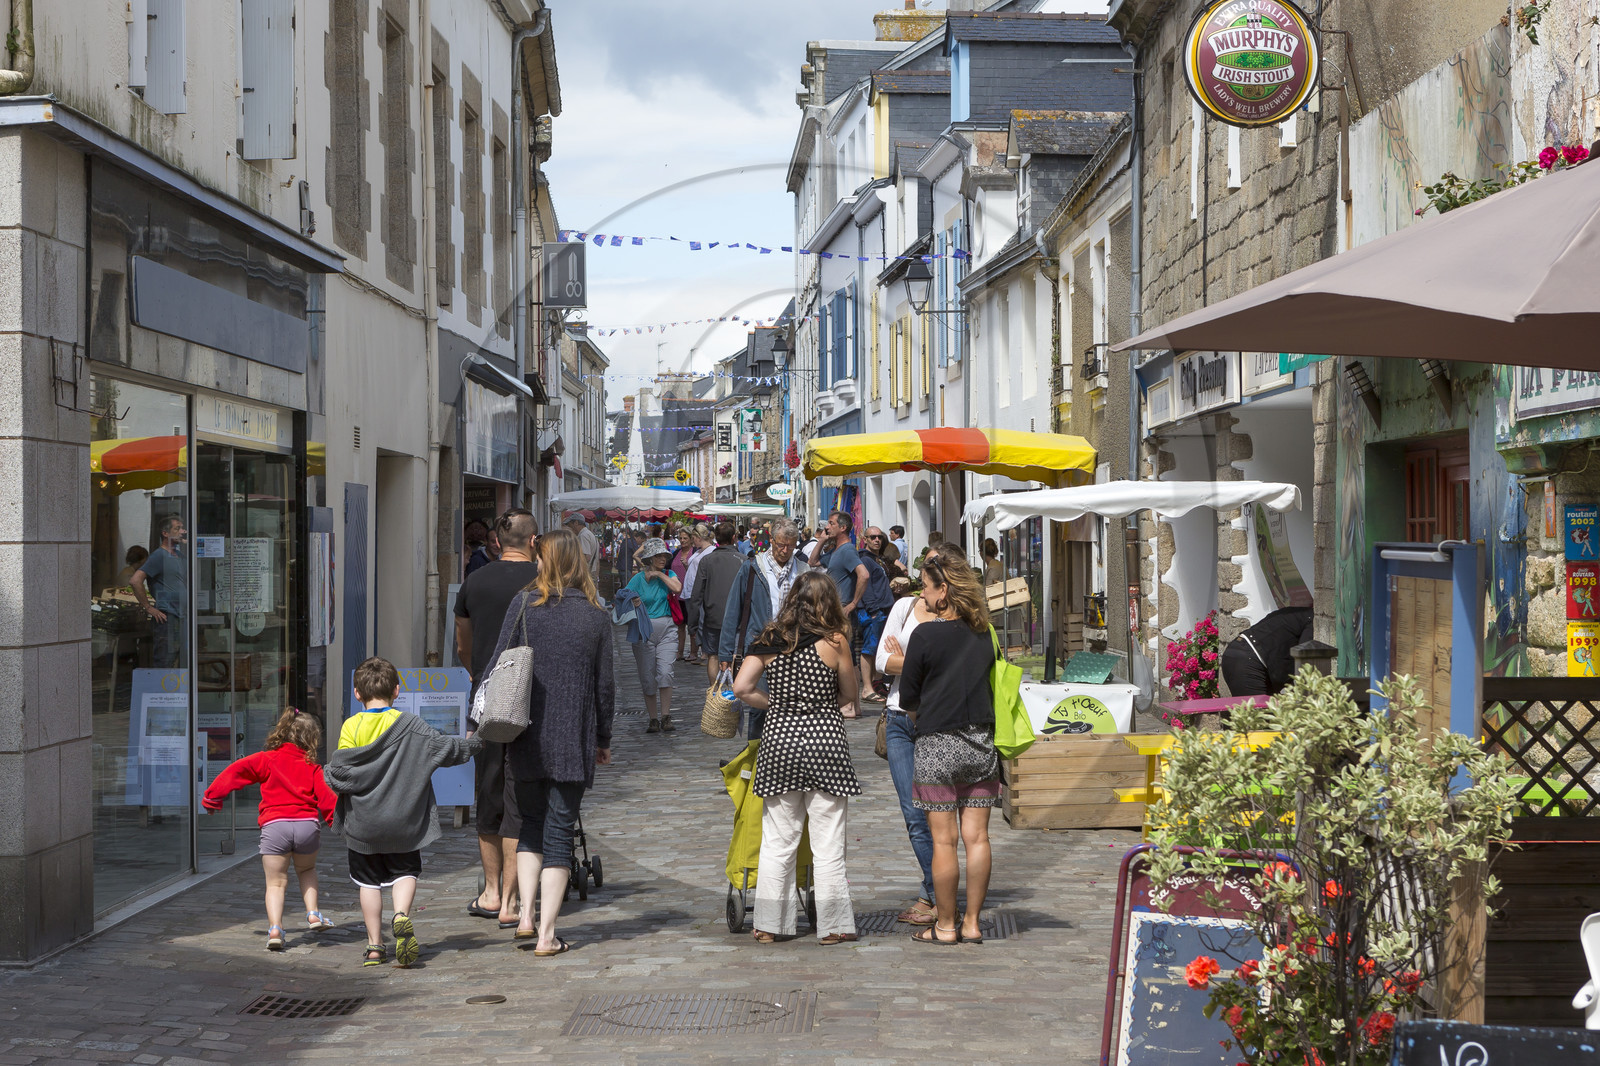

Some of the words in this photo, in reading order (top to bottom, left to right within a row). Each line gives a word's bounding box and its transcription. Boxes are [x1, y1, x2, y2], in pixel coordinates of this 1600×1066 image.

[1214, 0, 1247, 27] EXTRA
[1248, 0, 1293, 28] QUALITY
[1212, 30, 1294, 53] MURPHY'S
[1218, 67, 1252, 83] IRISH
[1253, 68, 1290, 83] STOUT
[1213, 83, 1235, 107] LADY'S
[1235, 102, 1257, 114] WELL
[1259, 84, 1293, 113] BREWERY
[1198, 352, 1227, 397] Pressing
[1520, 365, 1543, 399] LA
[1569, 577, 1597, 586] 1998
[1570, 638, 1599, 647] 1999
[397, 668, 449, 692] XPO
[1053, 705, 1069, 717] Ty
